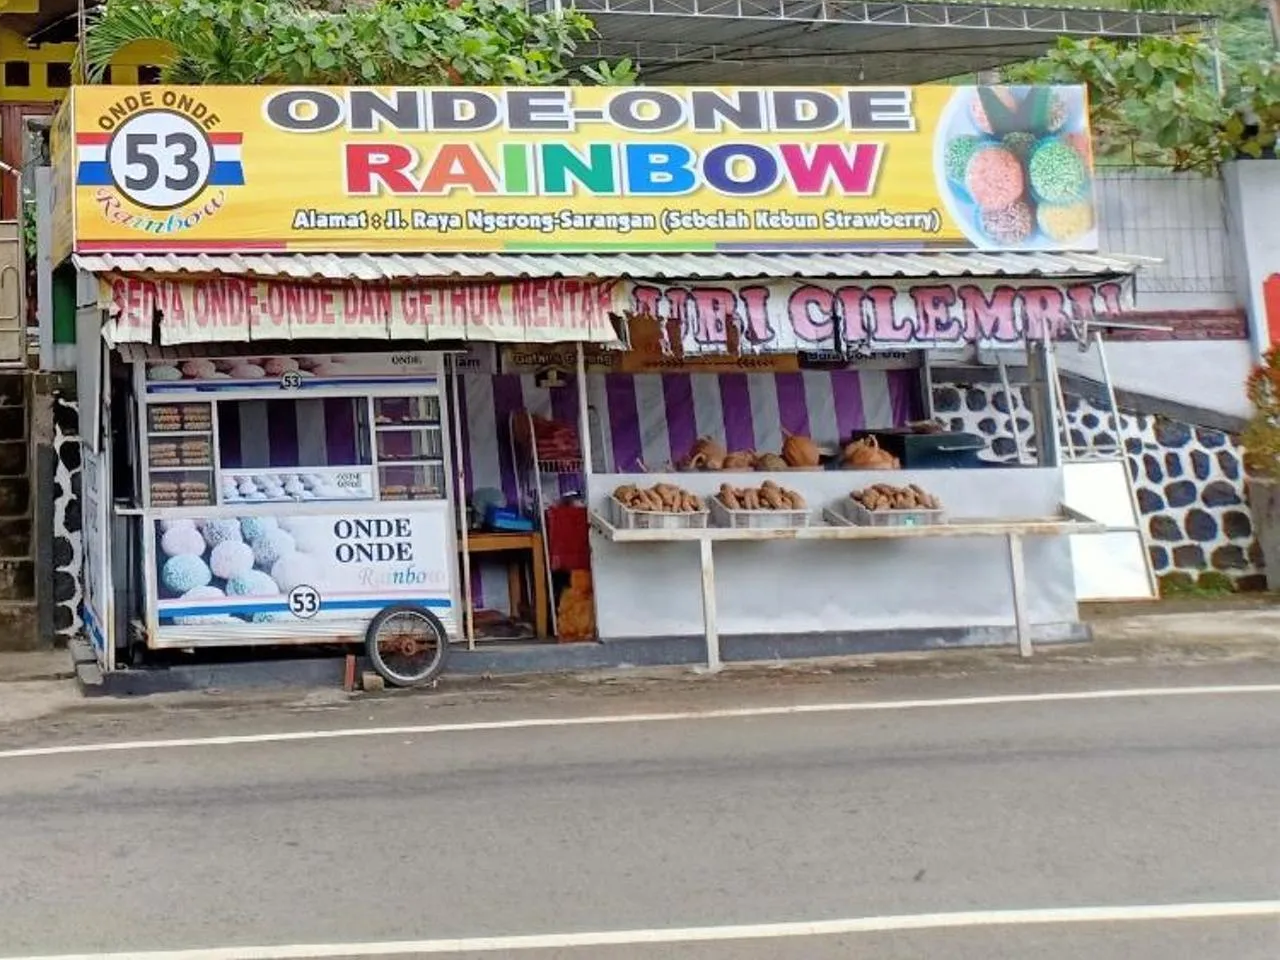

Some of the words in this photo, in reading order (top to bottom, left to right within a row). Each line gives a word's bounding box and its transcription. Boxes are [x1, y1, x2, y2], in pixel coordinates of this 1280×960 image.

[97, 90, 155, 131] ONDE
[161, 90, 222, 131] ONDE
[266, 89, 914, 132] ONDE-ONDE
[124, 132, 201, 191] 53
[345, 142, 884, 195] RAINBOW
[96, 188, 226, 234] Rainbow
[292, 209, 367, 229] Alamat
[384, 209, 408, 229] Jl.
[411, 209, 462, 233] Raya
[466, 209, 656, 233] Ngerong-Sarangan
[660, 209, 750, 233] (Sebelah
[754, 209, 819, 229] Kebun
[824, 209, 942, 233] Strawberry)
[112, 277, 187, 328] SEDIA
[193, 278, 336, 328] ONDE-ONDE
[343, 281, 392, 326] DAN
[401, 279, 504, 327] GETHUK
[512, 277, 615, 329] MENTAH
[284, 375, 299, 388] 53
[333, 518, 412, 539] ONDE
[335, 542, 414, 562] ONDE
[293, 593, 317, 612] 53
